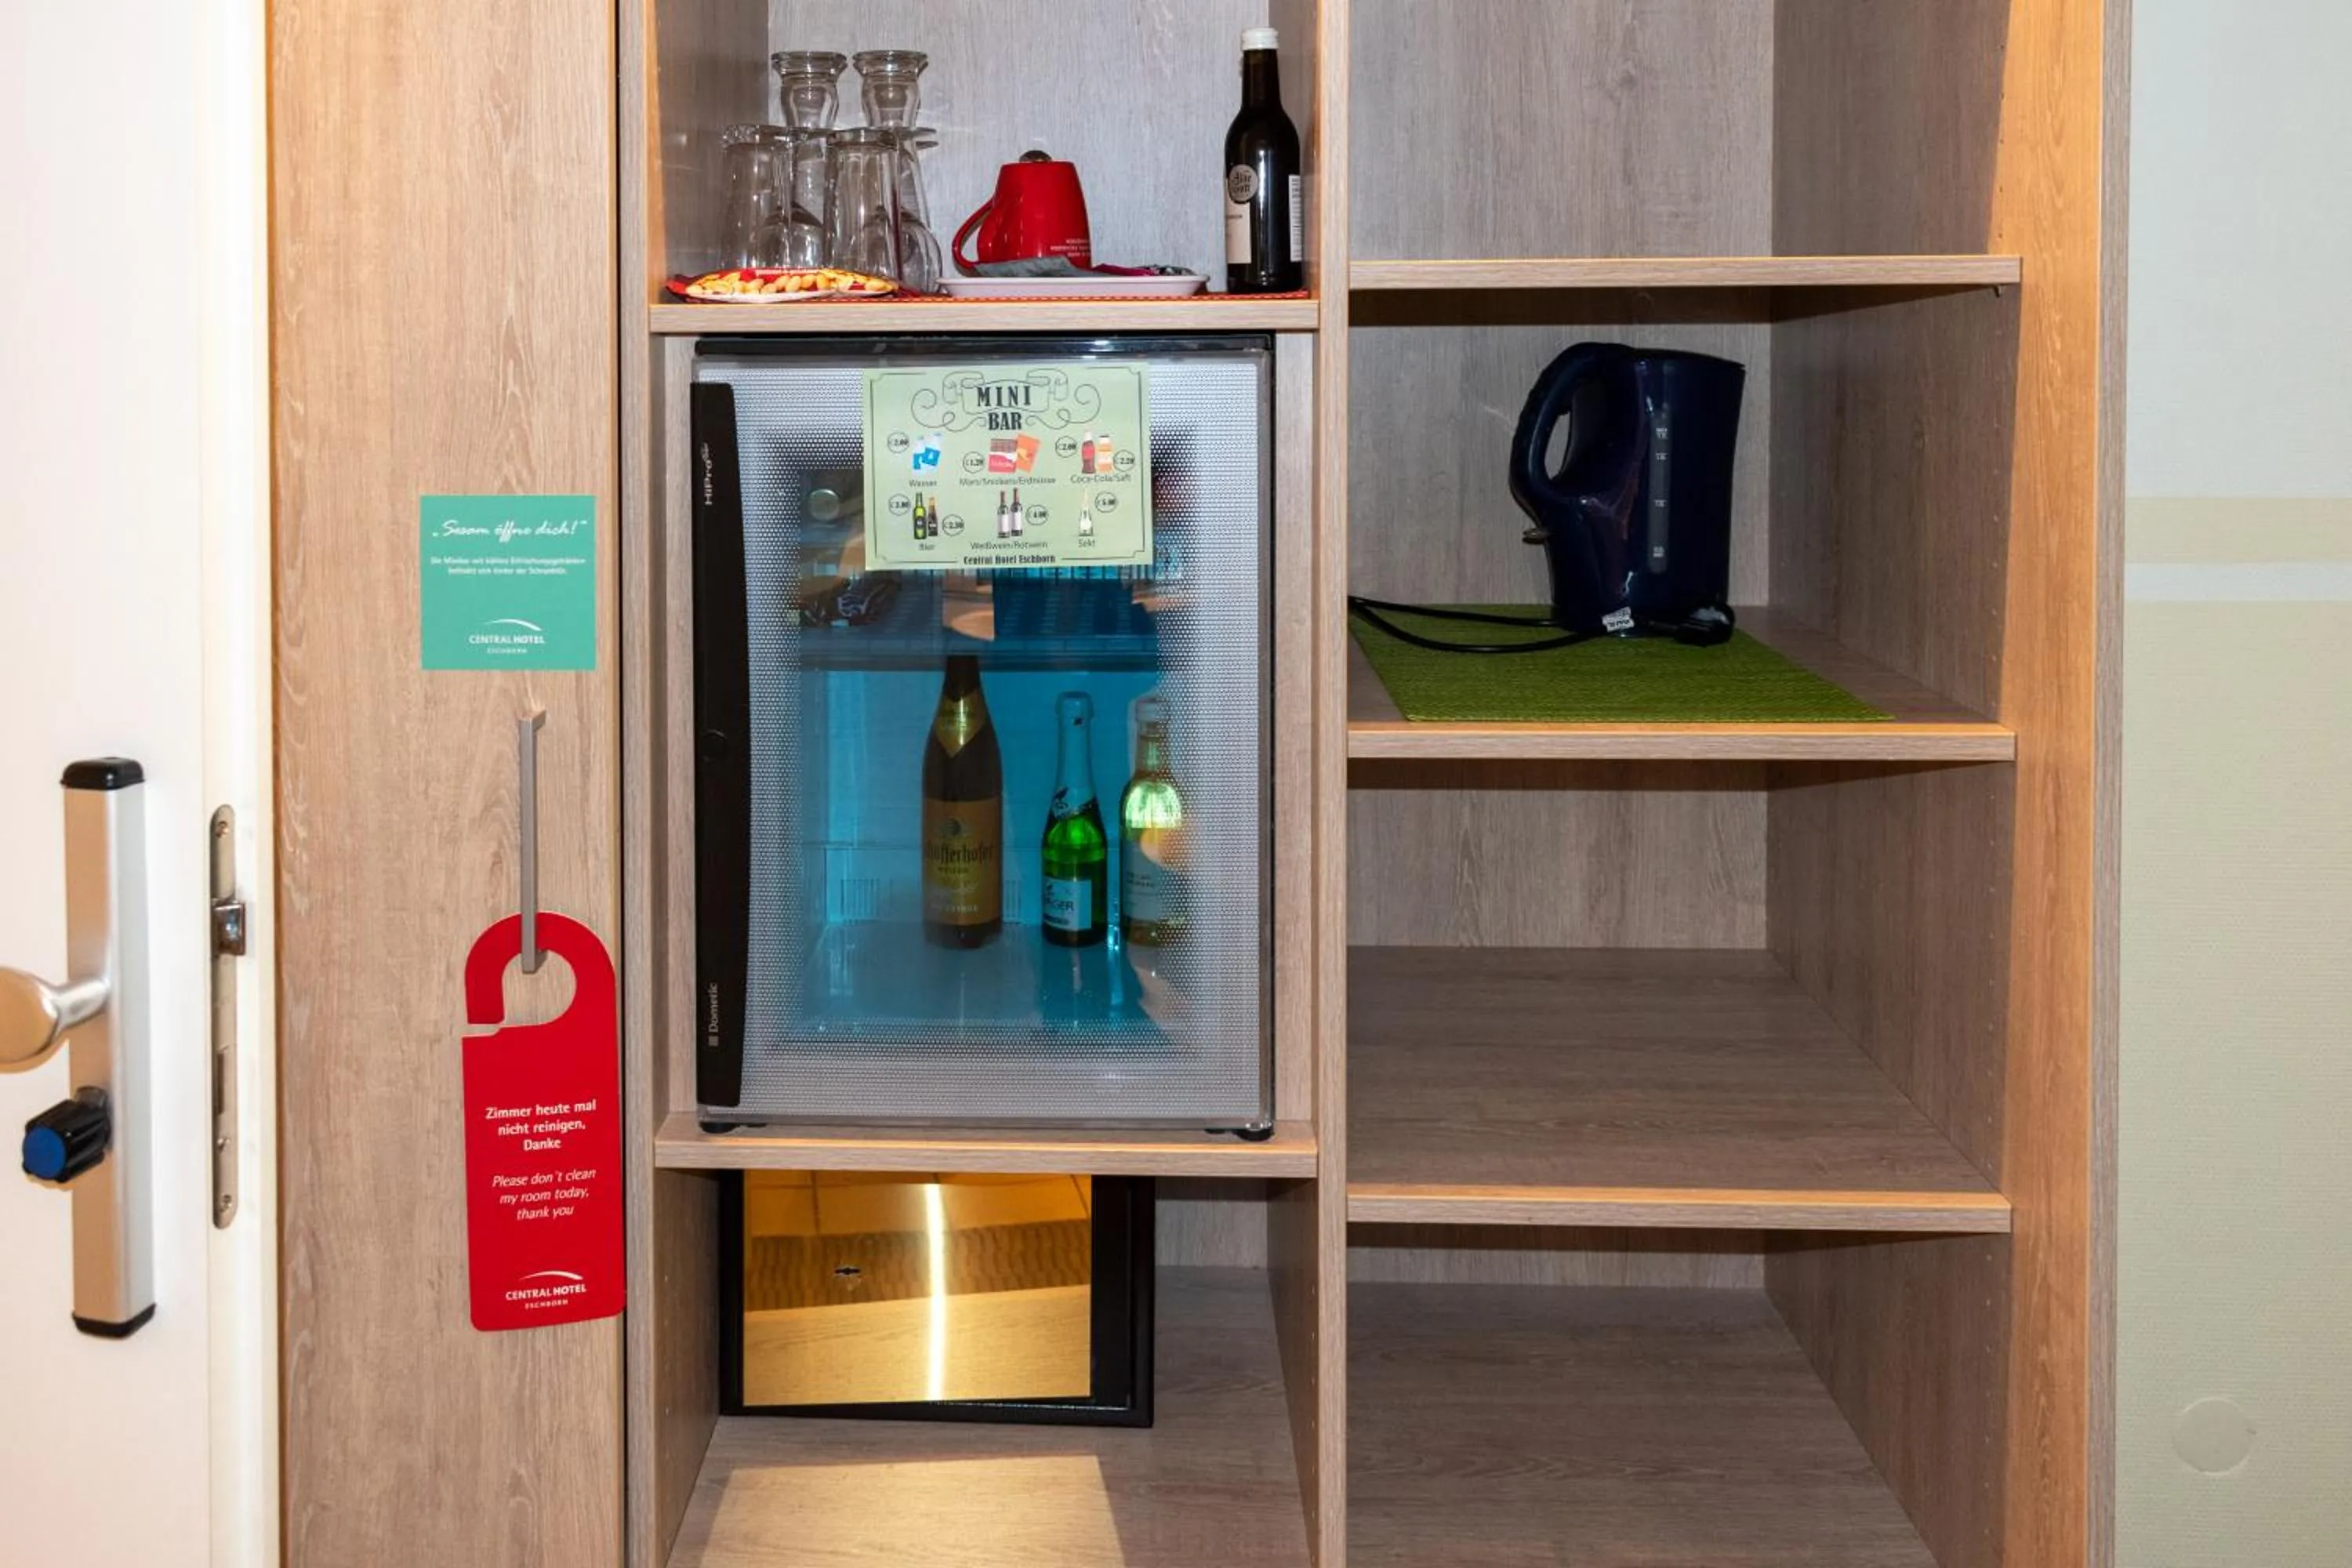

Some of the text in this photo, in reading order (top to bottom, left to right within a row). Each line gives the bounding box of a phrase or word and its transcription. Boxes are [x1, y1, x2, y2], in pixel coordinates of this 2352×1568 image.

[977, 385, 1032, 407] MINI
[988, 412, 1022, 430] BAR
[909, 479, 938, 488] Wasser
[918, 543, 935, 552] Bier
[1078, 539, 1096, 548] Sekt
[964, 554, 1055, 566] Central Hotel Eschborn
[468, 635, 546, 644] CENTRAL HOTEL
[485, 1099, 597, 1120] Zimmer heute mal
[498, 1120, 586, 1136] nicht reinigen.
[523, 1138, 562, 1152] Danke
[492, 1173, 528, 1188] Please
[565, 1169, 597, 1181] clean
[499, 1192, 517, 1206] my
[520, 1190, 552, 1203] room
[516, 1205, 575, 1221] thank you
[505, 1284, 586, 1301] CENTRAL HOTEL
[524, 1298, 569, 1309] ESCHBORN
